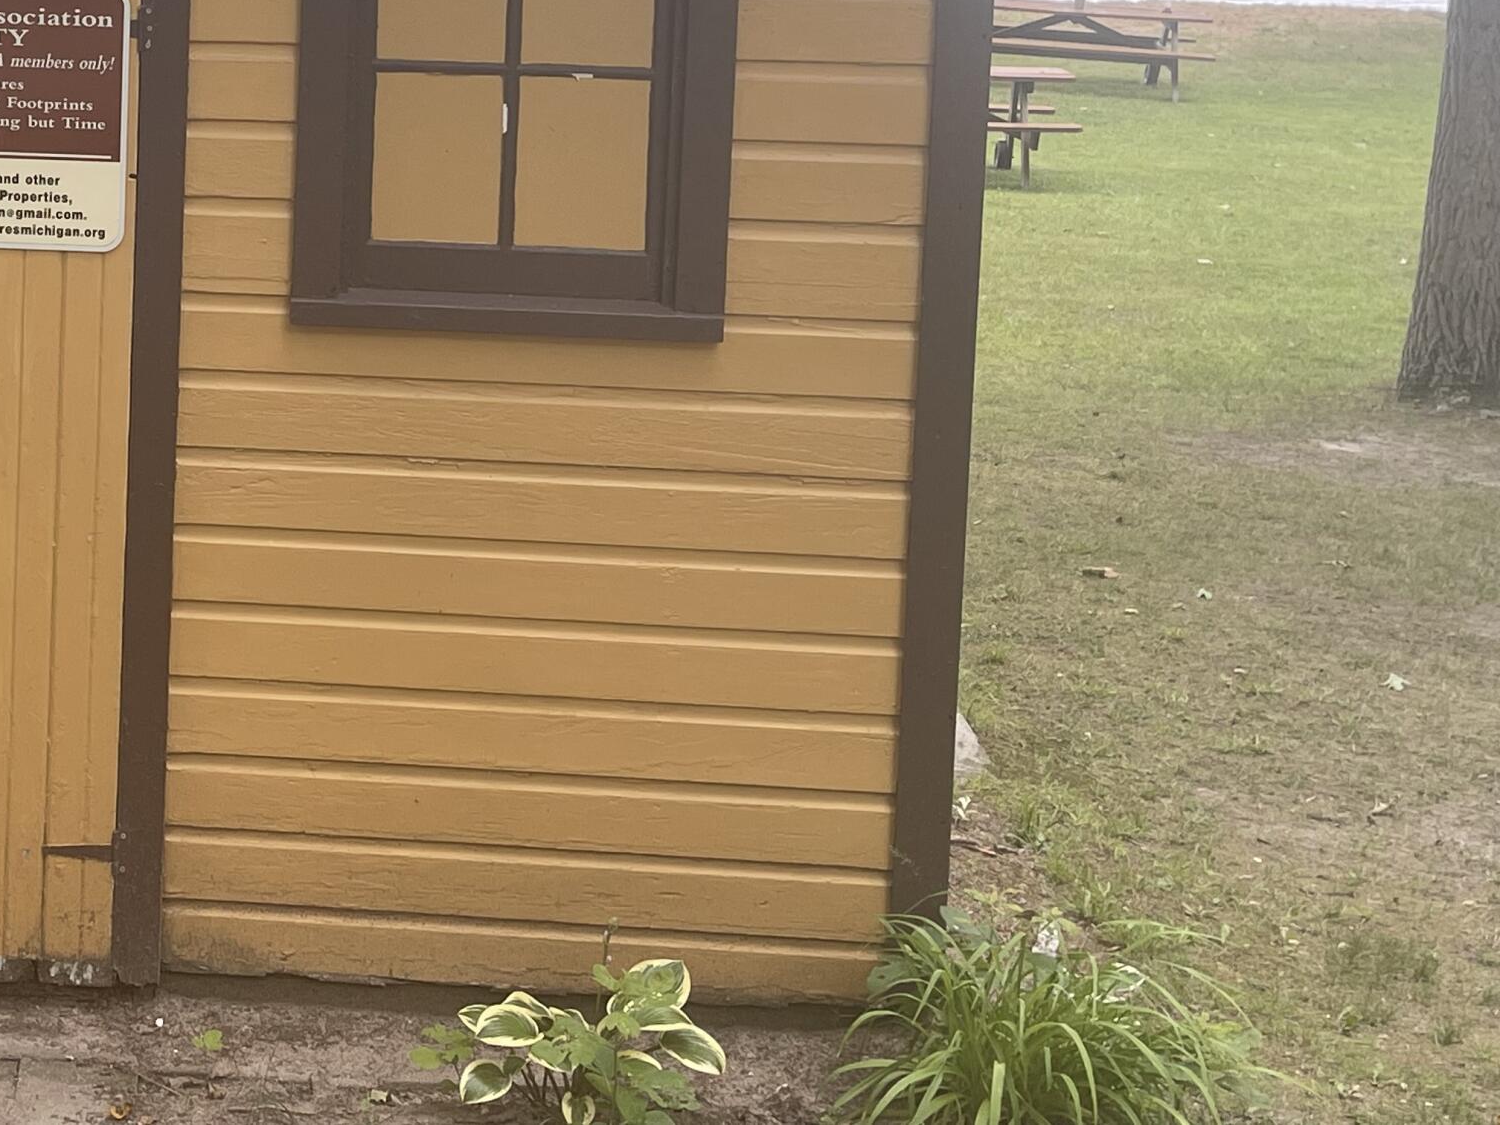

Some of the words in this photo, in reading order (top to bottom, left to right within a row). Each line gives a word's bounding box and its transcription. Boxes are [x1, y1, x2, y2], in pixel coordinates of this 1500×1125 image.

[10, 53, 74, 70] members
[79, 54, 116, 75] only!
[6, 96, 93, 113] Footprints
[28, 115, 55, 129] but
[61, 116, 106, 131] Time
[25, 174, 61, 186] other
[0, 189, 73, 206] Properties,
